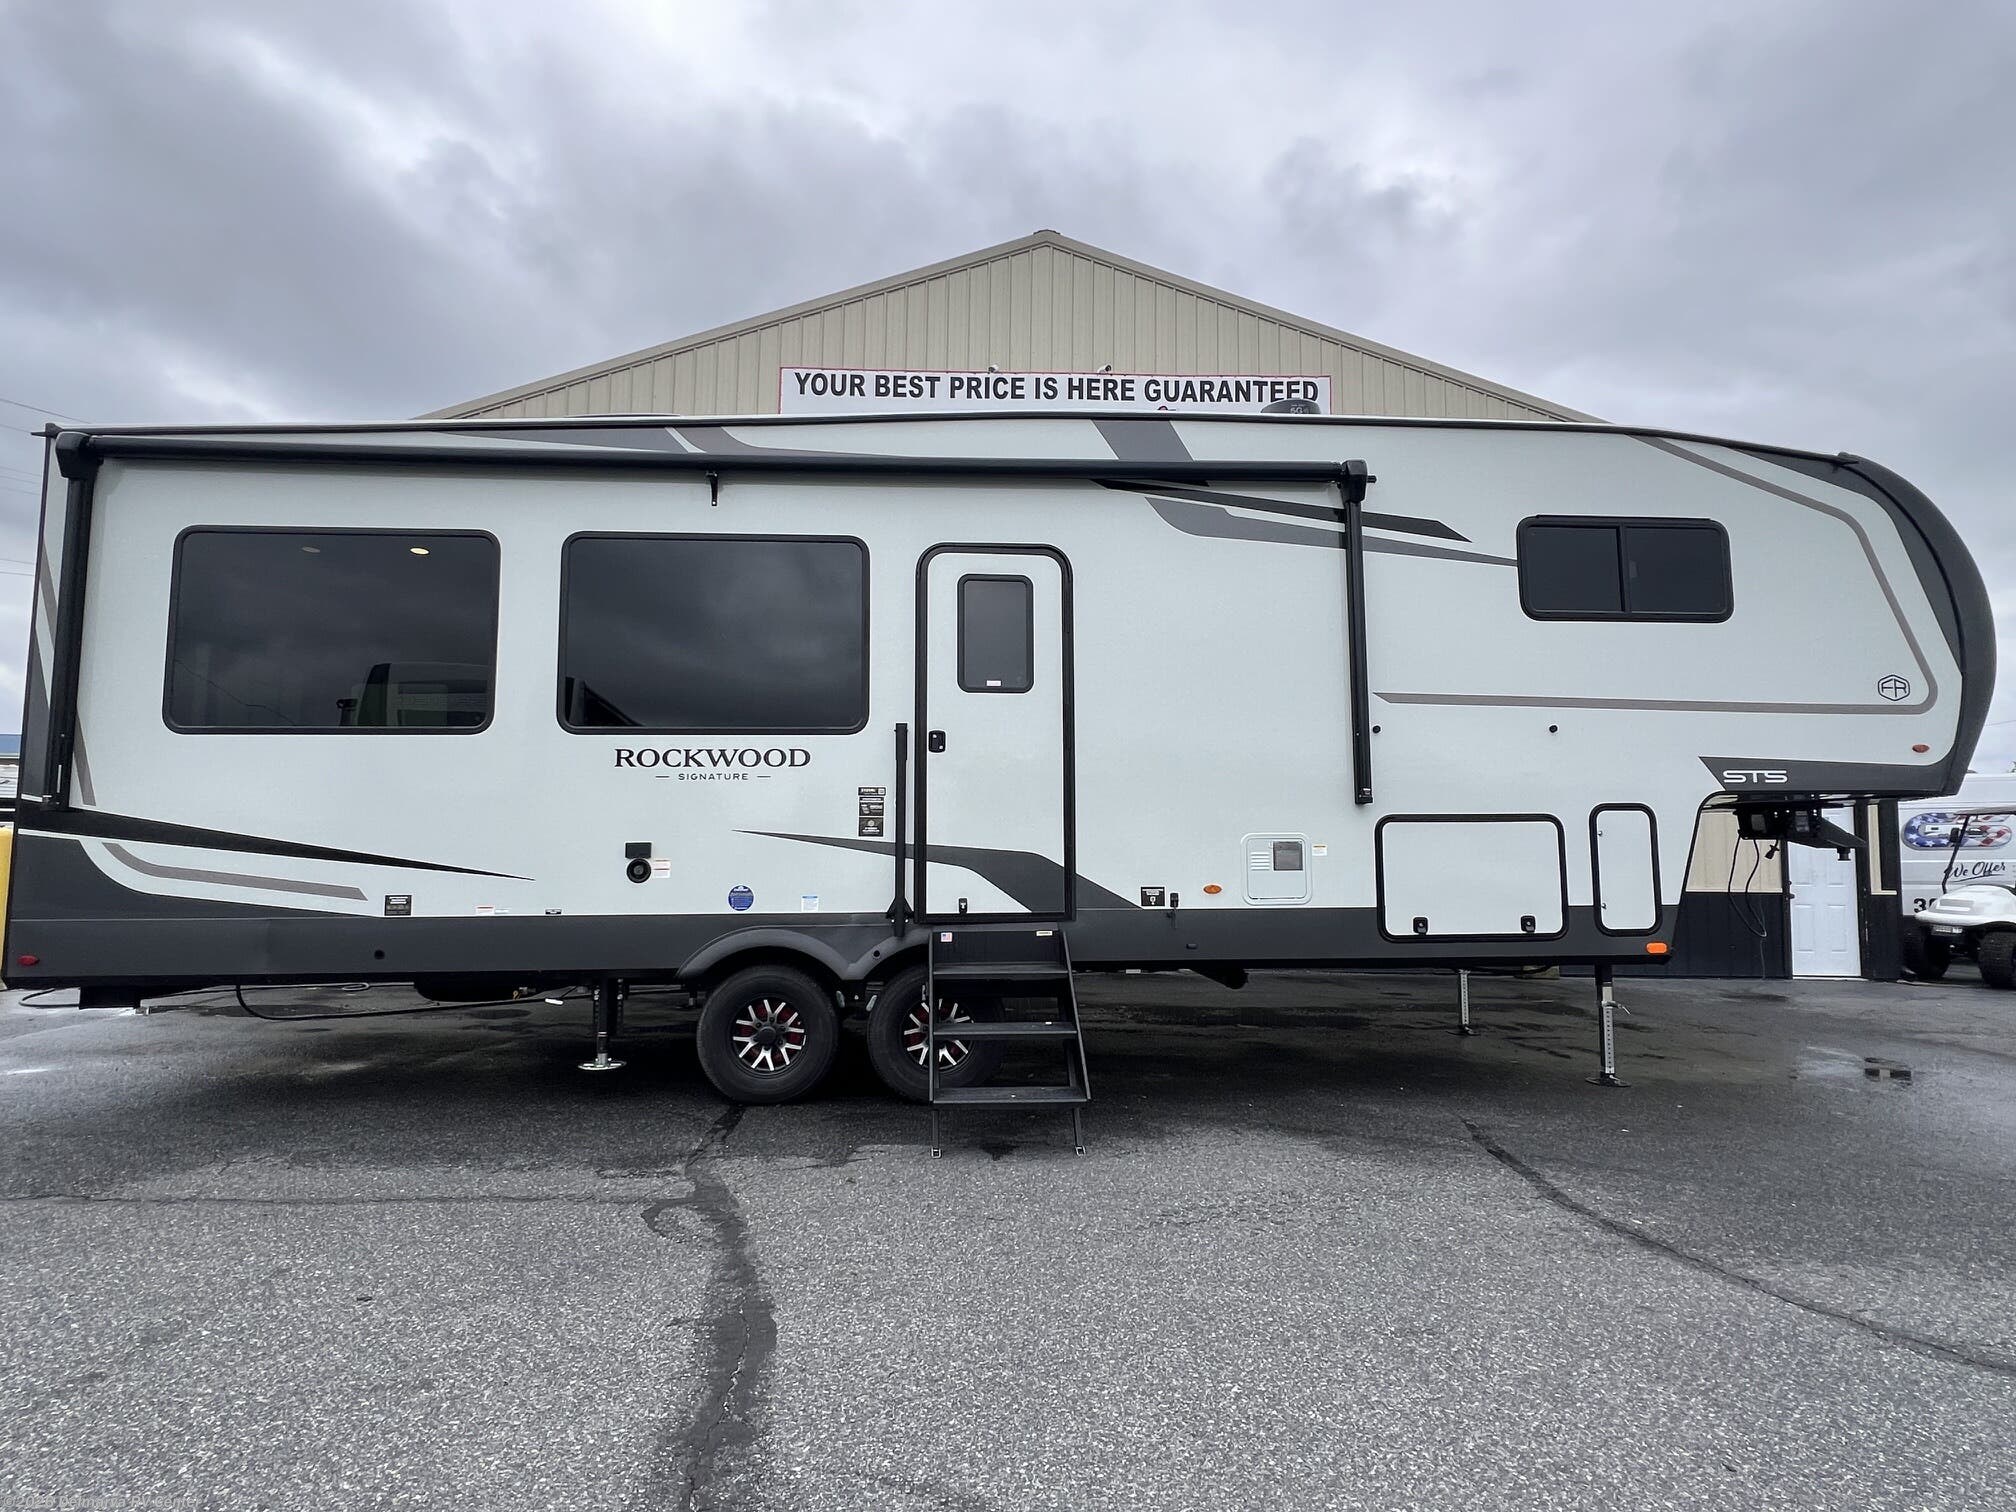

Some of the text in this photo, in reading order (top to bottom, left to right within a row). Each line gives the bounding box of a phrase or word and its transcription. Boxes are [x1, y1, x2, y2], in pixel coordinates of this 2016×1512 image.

[794, 372, 1319, 403] YOUR BEST PRICE IS HERE GUARANTEED
[614, 748, 811, 768] ROCKWOOD
[678, 773, 749, 781] SIGNATURE
[1722, 770, 1788, 783] STS
[1950, 863, 1969, 878] We
[1972, 861, 2006, 876] Offer
